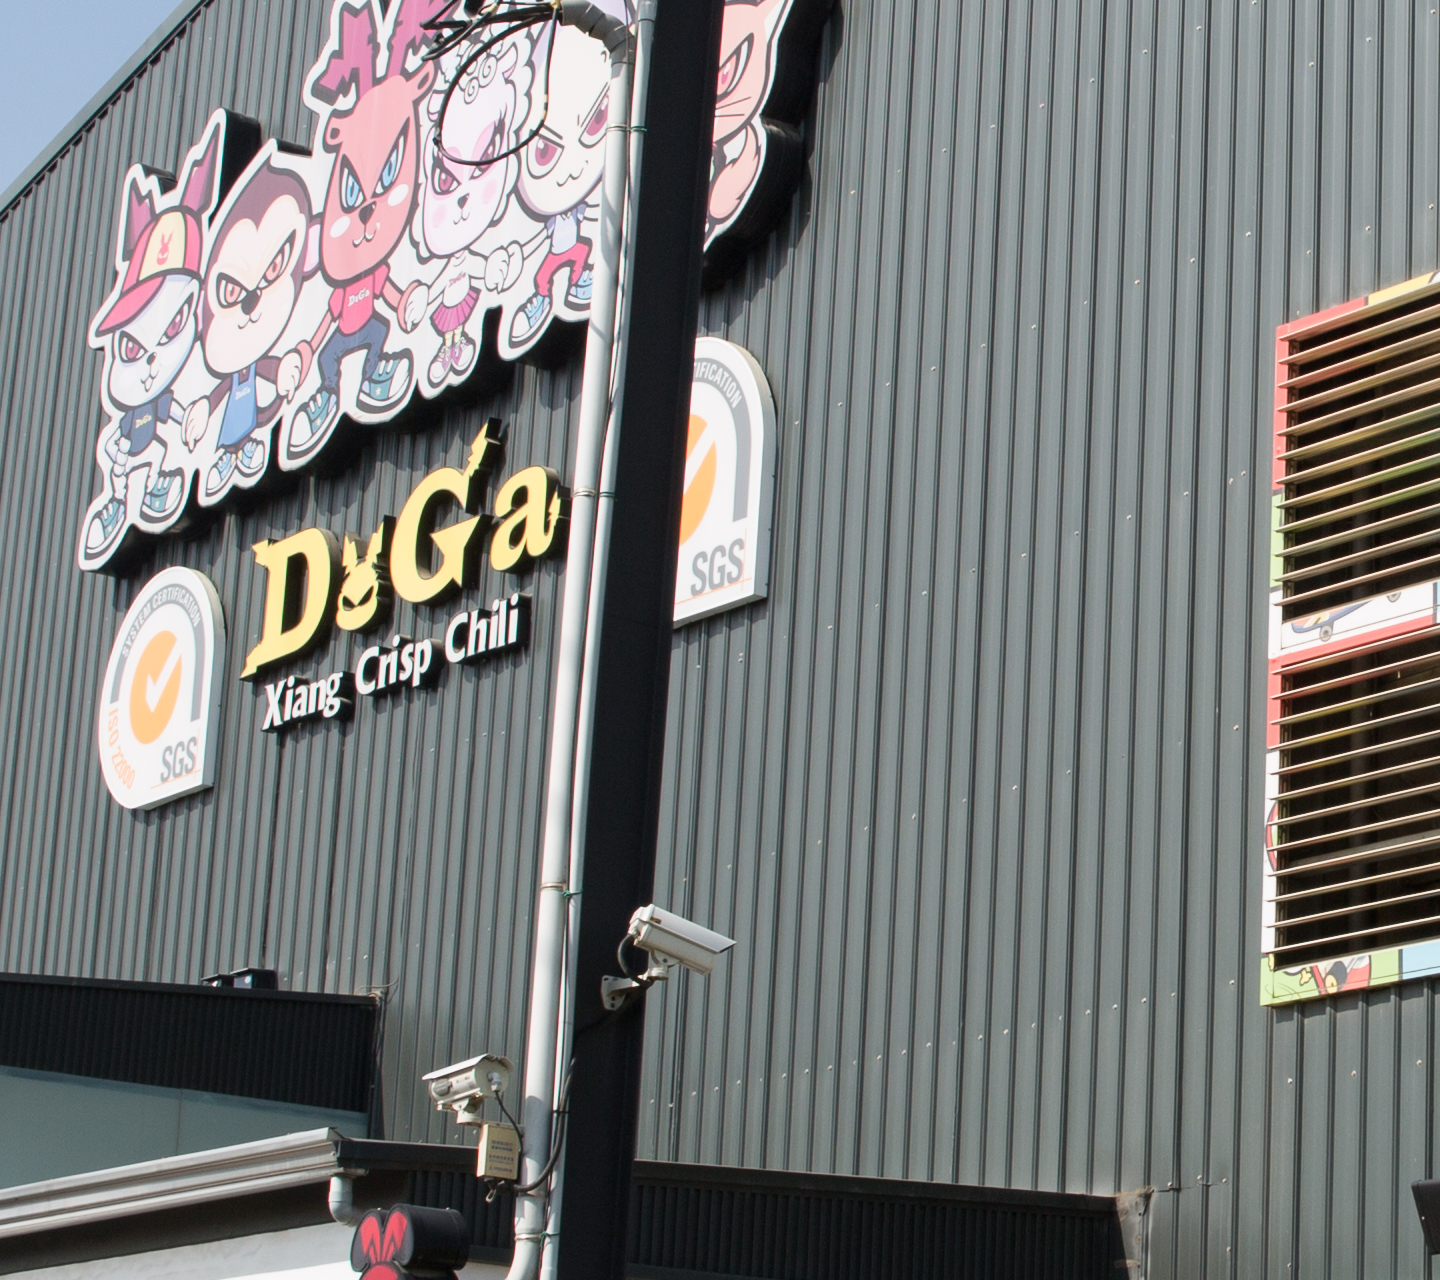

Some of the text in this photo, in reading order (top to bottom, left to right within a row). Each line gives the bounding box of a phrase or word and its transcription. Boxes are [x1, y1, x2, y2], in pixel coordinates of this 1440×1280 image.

[694, 361, 742, 408] IFICATION
[691, 538, 744, 597] SGS
[122, 587, 201, 658] SYSTEM CERTIFICATION
[261, 593, 519, 731] Xiang Crisp Chili
[108, 708, 136, 790] ISO 22000
[160, 736, 197, 783] SGS
